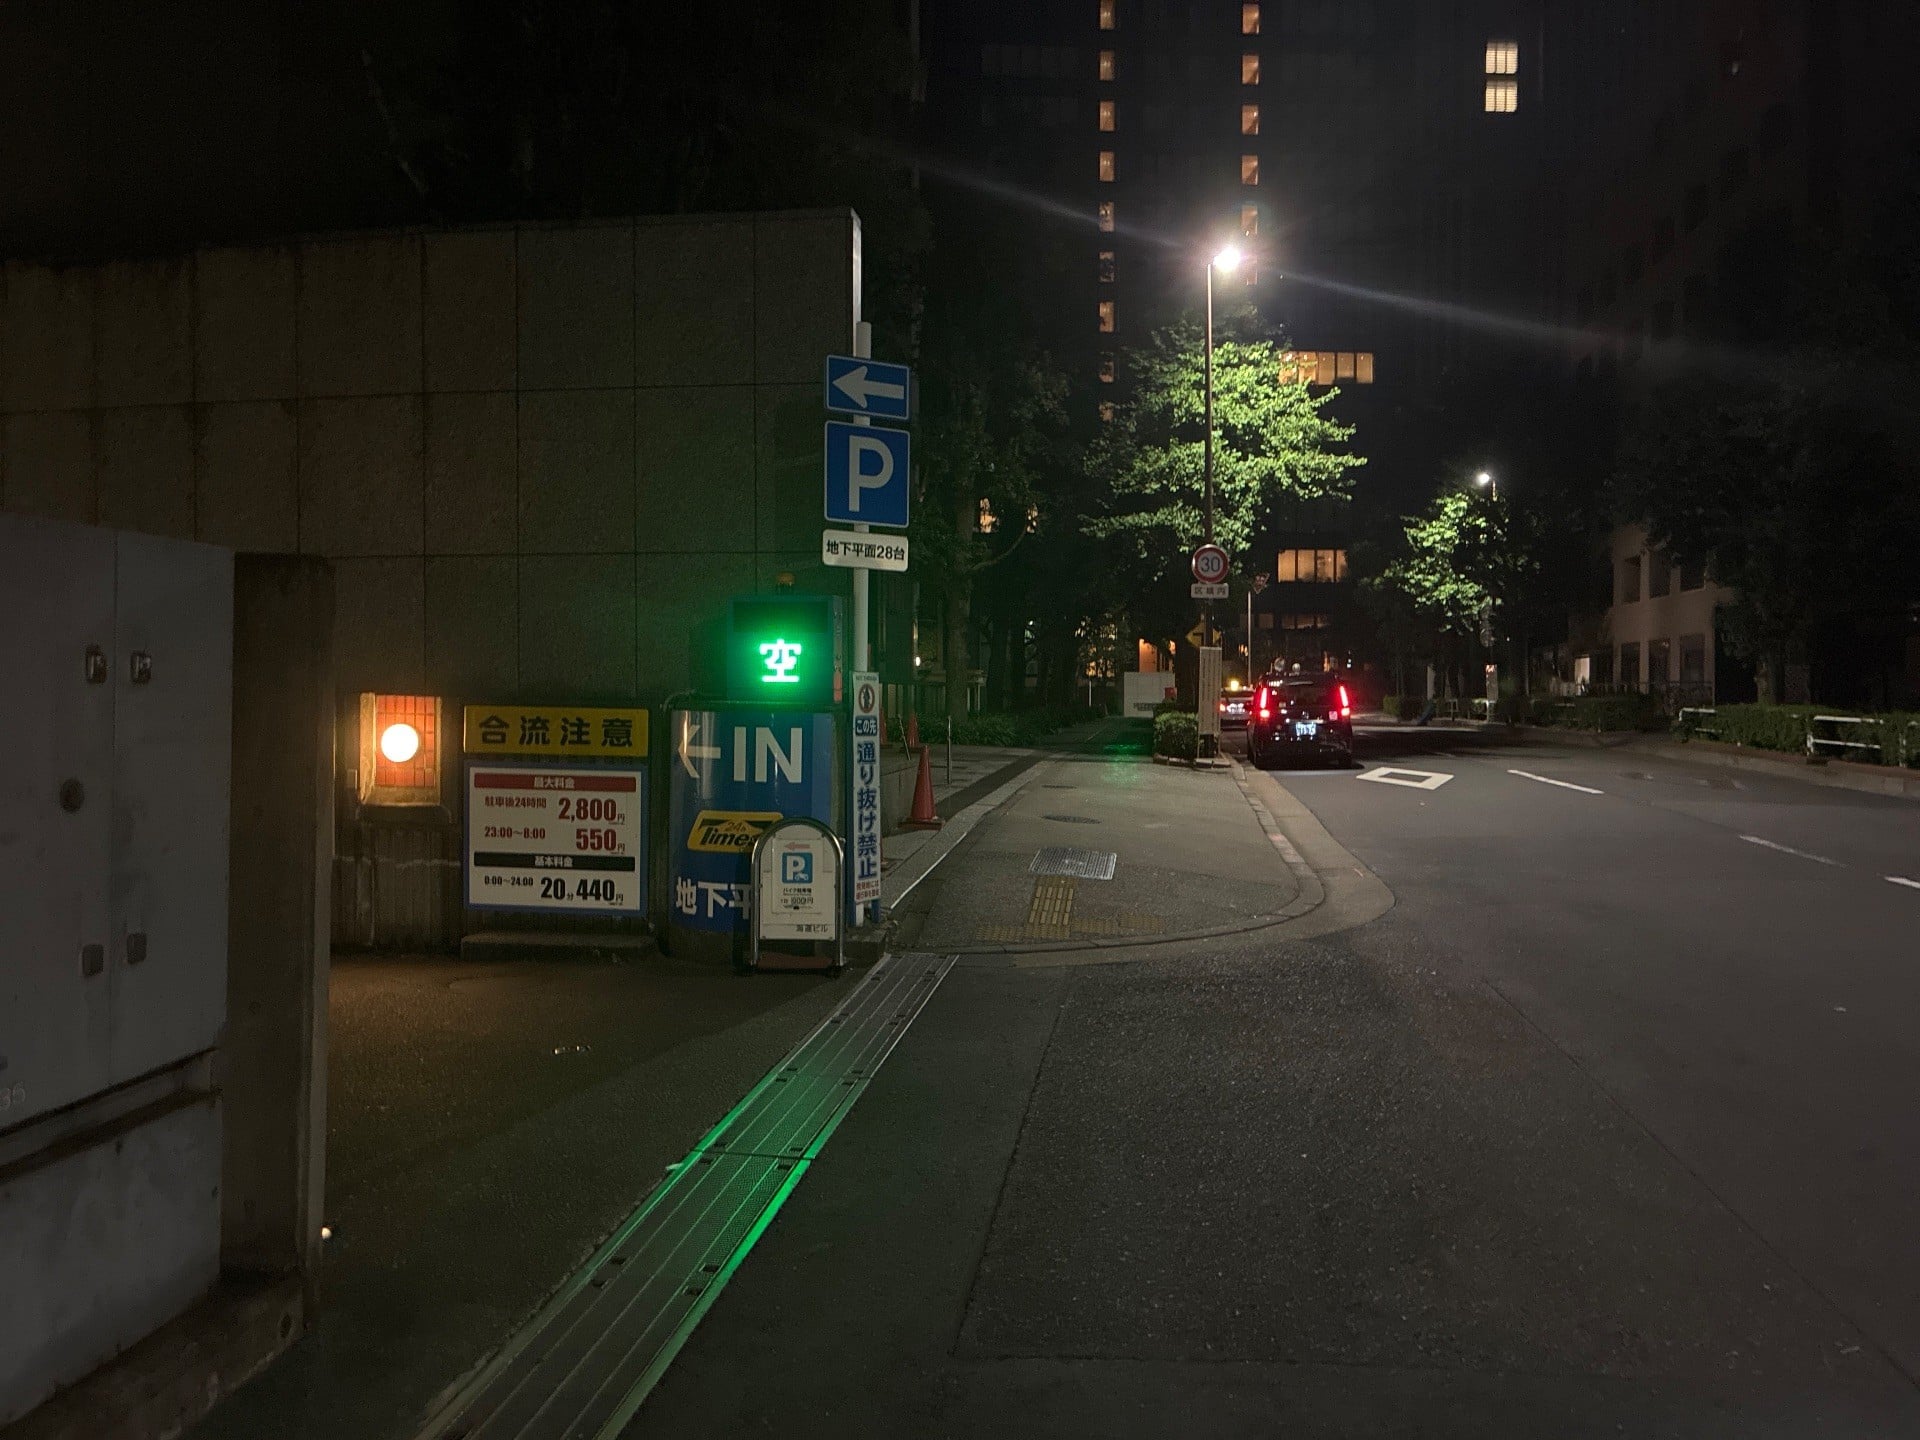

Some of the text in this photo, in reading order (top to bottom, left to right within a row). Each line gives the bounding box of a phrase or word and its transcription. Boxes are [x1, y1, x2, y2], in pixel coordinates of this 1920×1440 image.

[849, 434, 894, 512] P
[826, 539, 905, 560] 地下平面28台
[1201, 556, 1220, 572] 30
[759, 638, 803, 683] 空
[479, 715, 633, 747] 合流注意
[856, 718, 877, 734] この先
[733, 726, 803, 784] IN
[558, 798, 626, 823] 2,800円
[857, 742, 877, 879] 通り抜け禁止
[576, 829, 626, 853] 550円
